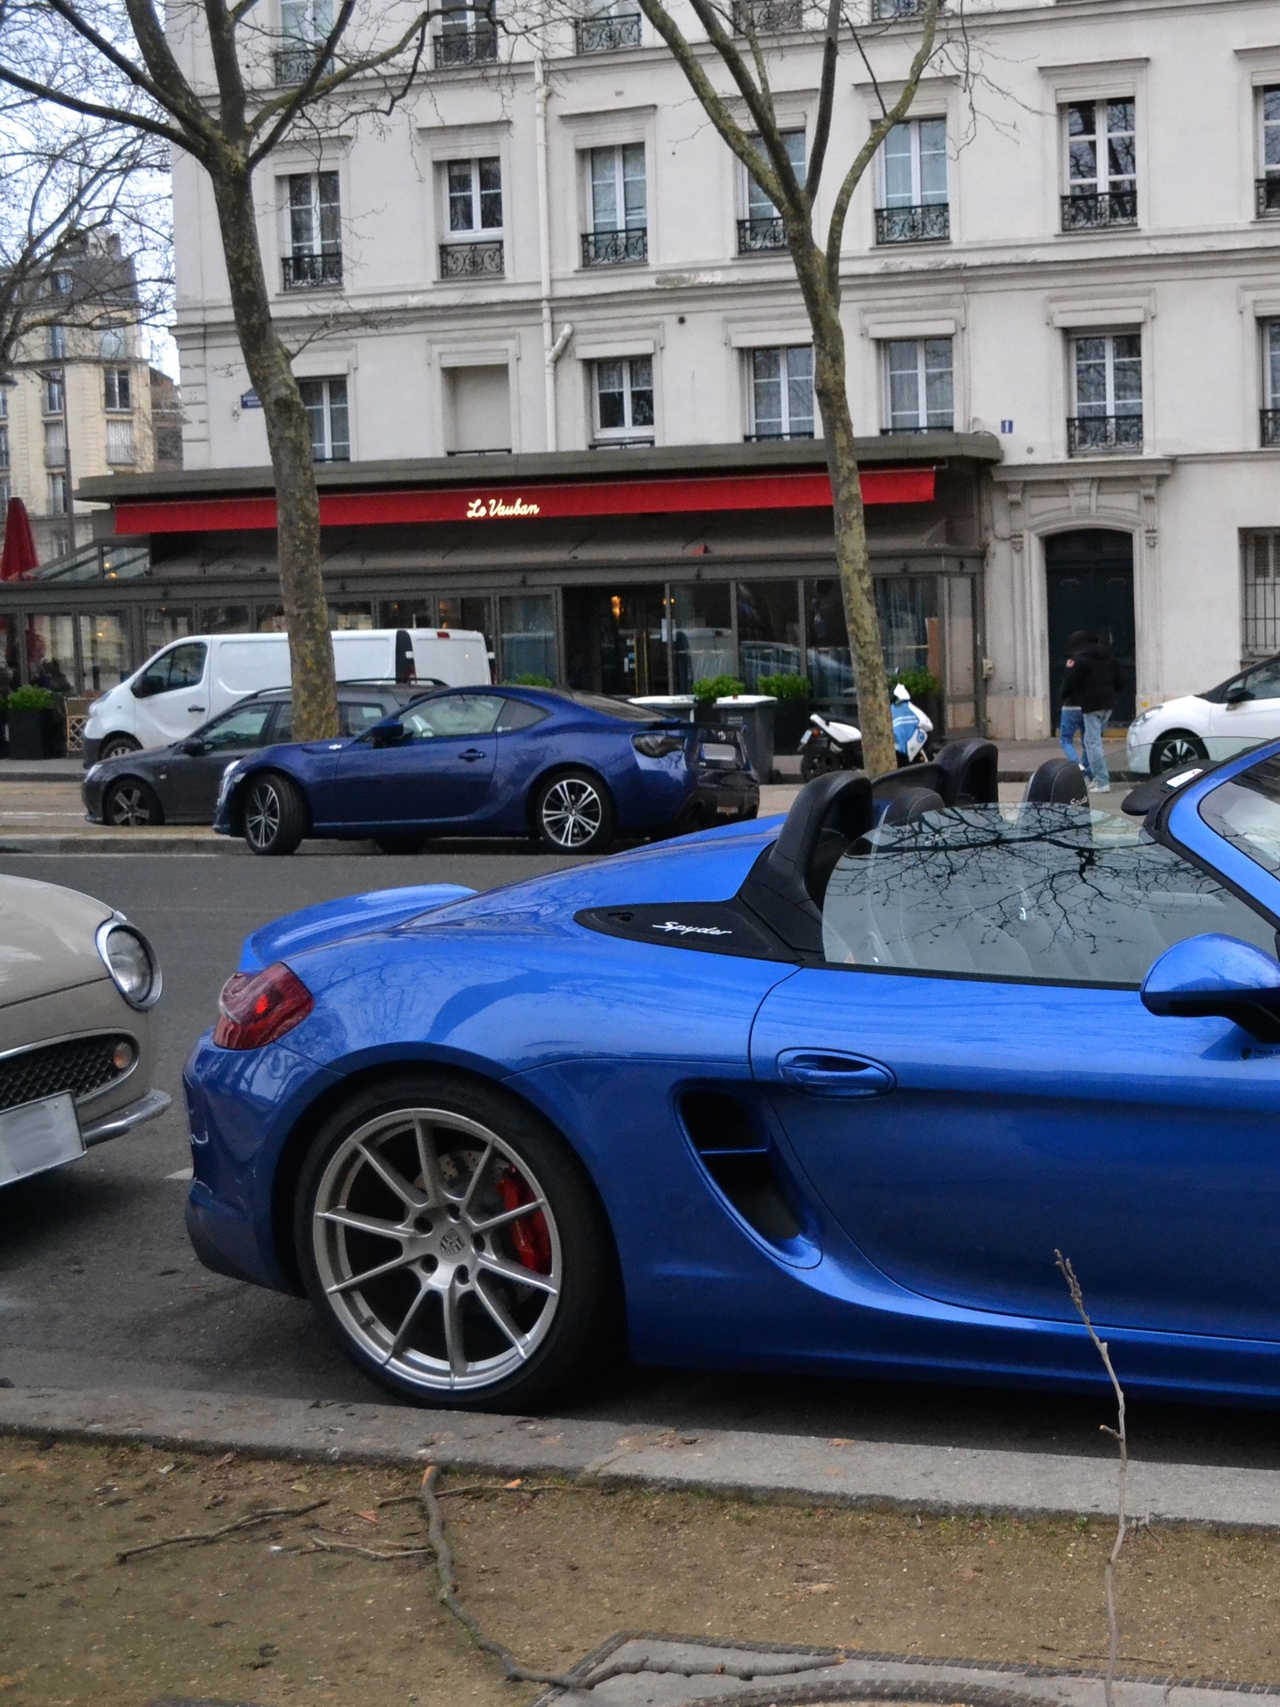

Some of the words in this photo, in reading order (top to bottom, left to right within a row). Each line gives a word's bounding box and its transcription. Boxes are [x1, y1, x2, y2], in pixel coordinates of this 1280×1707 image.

[467, 498, 487, 518] Le
[489, 497, 540, 517] Vauban
[652, 921, 733, 935] Spyder
